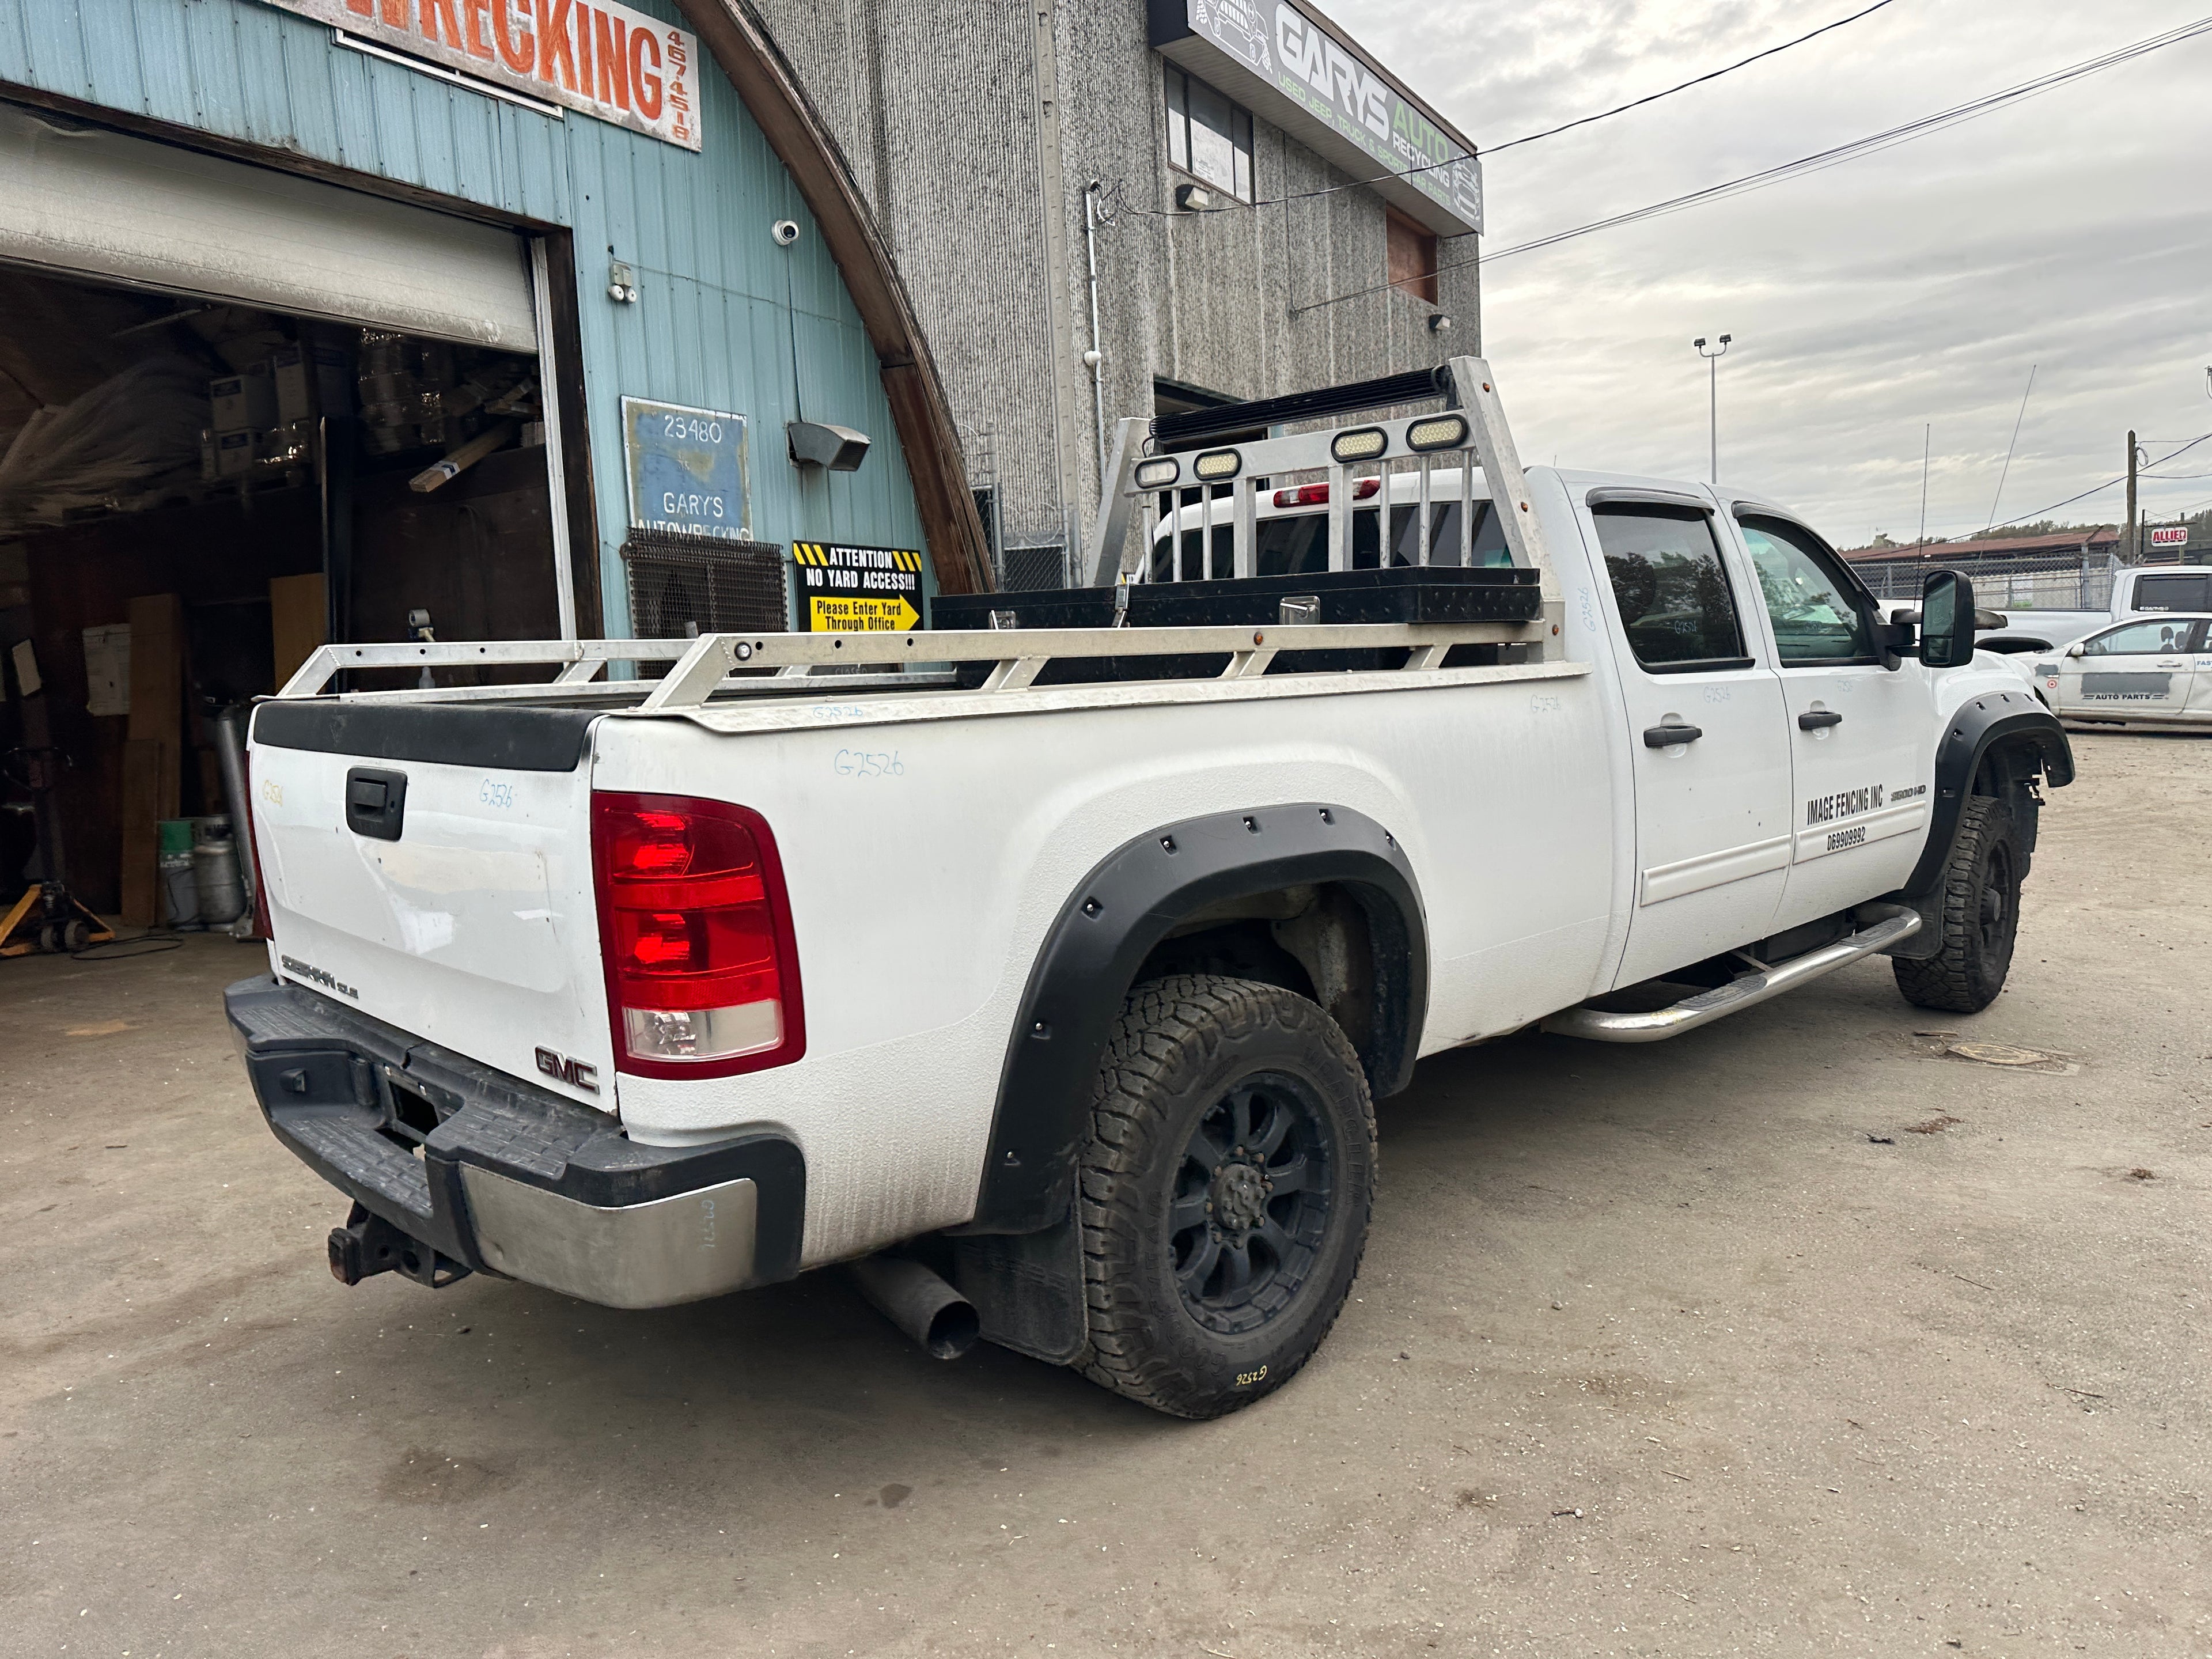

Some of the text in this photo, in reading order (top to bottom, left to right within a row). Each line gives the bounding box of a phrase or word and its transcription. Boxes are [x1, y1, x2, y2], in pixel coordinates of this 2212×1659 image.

[1275, 3, 1389, 141] GARYS
[1278, 71, 1306, 103] USED
[1336, 114, 1366, 146] TRUCK
[1429, 181, 1450, 206] PARTS
[1393, 100, 1449, 168] AUTO
[1392, 131, 1450, 188] RECYCLING
[664, 415, 722, 443] 23480
[663, 492, 723, 518] GARY'S
[830, 547, 892, 569] ATTENTION
[806, 568, 915, 590] NO YARD ACCESS!!!
[817, 600, 901, 616] Please Enter Yard
[825, 616, 895, 631] Through Office
[834, 749, 904, 778] G2526
[1807, 784, 1883, 825] IMAGE FENCING INC
[1827, 826, 1866, 851] 069909992
[535, 1045, 600, 1095] GMC
